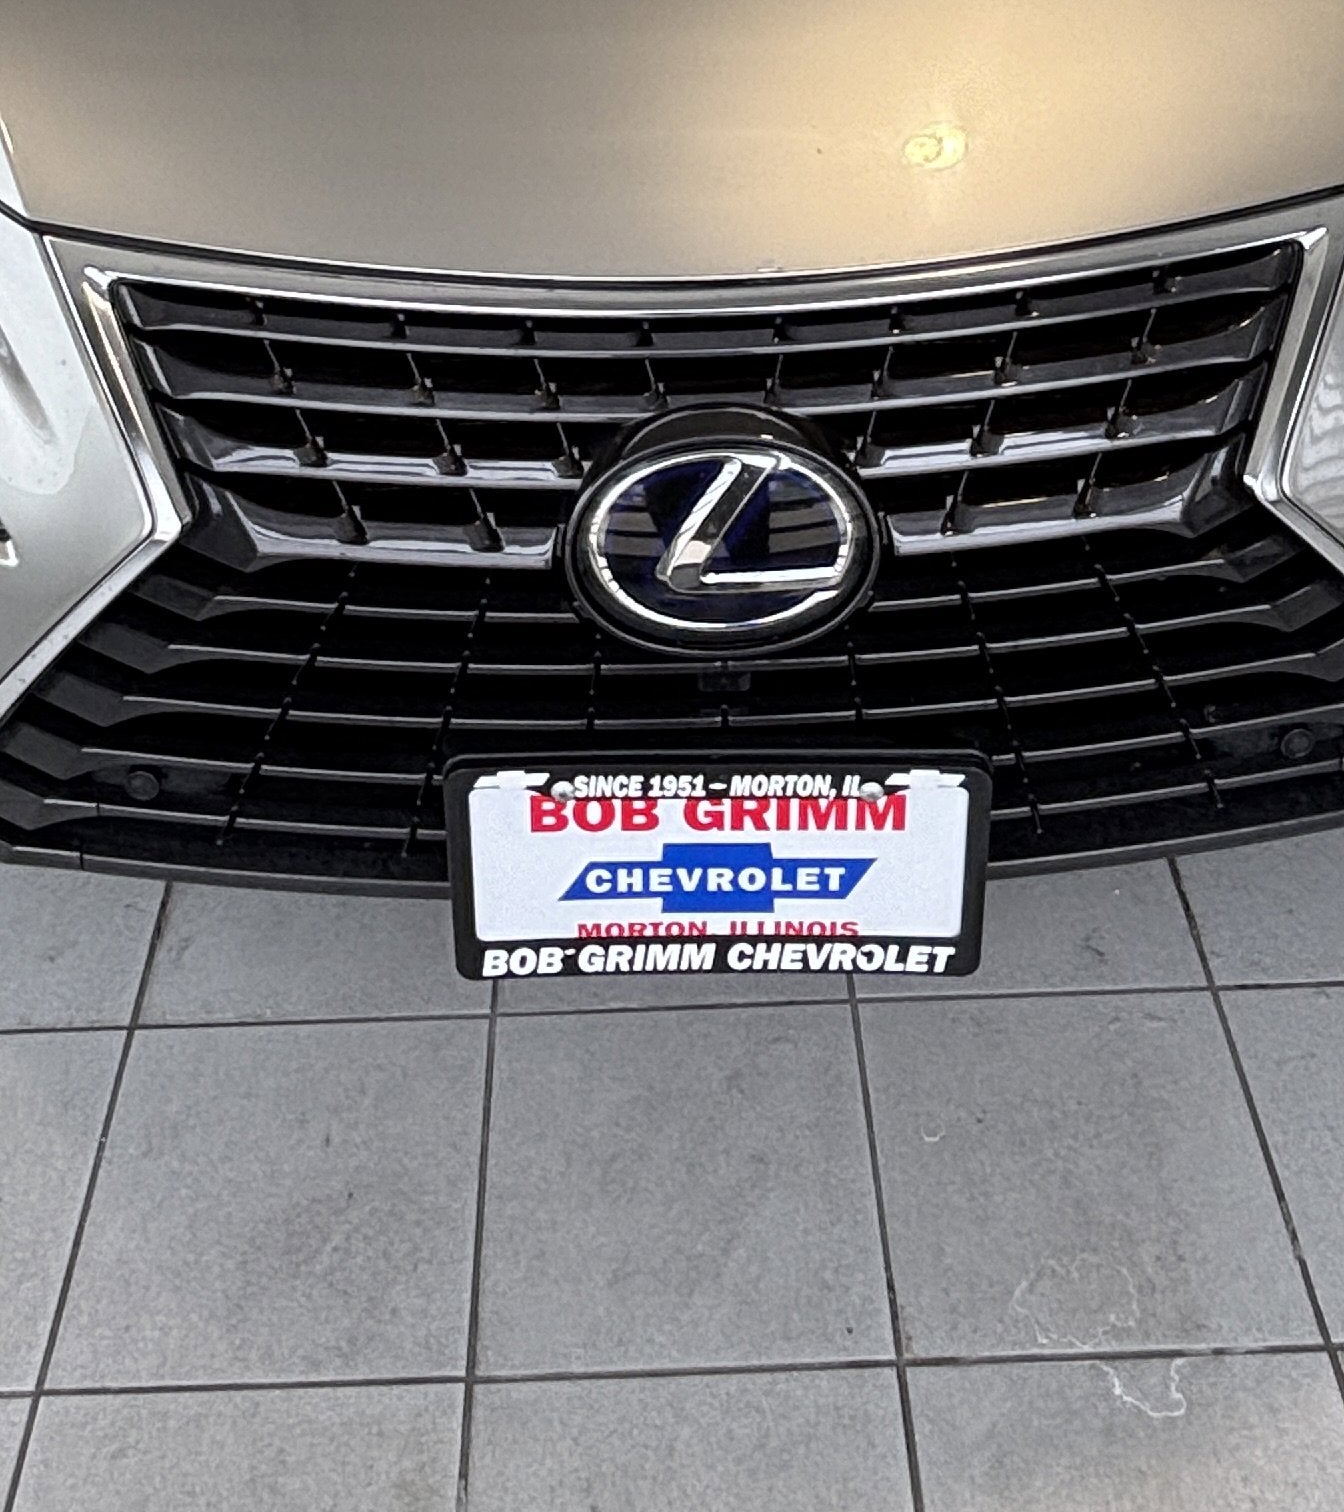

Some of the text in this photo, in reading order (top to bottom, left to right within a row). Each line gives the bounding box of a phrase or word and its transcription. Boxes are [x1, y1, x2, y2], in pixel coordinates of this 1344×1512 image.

[573, 774, 645, 798] SINCE
[647, 774, 707, 797] 1951
[728, 774, 838, 801] MORTON,
[841, 774, 862, 797] IL
[529, 793, 907, 832] BOB GRIMM
[584, 863, 846, 893] CHEVROLET
[481, 942, 956, 978] BOB GRIMM CHEVROLET
